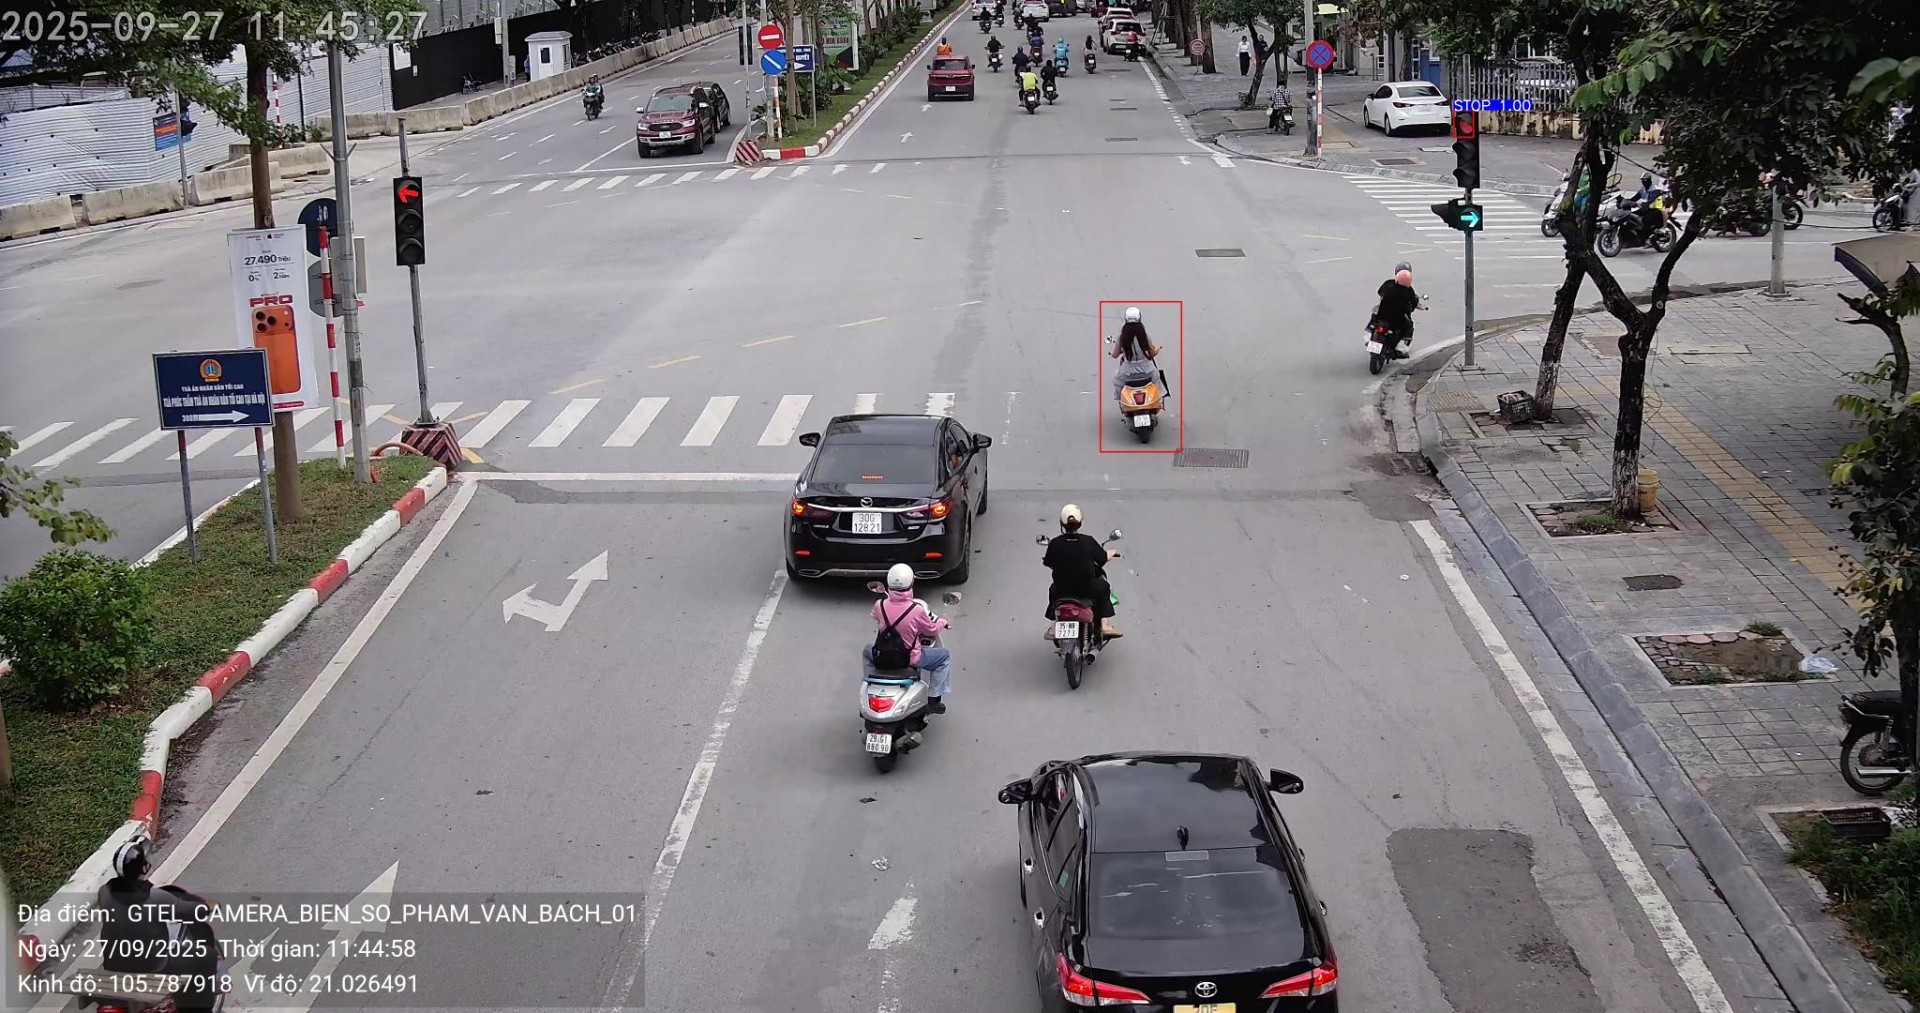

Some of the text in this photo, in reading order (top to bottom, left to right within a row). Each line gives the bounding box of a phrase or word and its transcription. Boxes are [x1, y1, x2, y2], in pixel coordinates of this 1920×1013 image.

[244, 254, 277, 265] 27.490
[249, 295, 293, 307] PRO
[860, 513, 875, 523] 30G
[854, 523, 880, 533] 128.21
